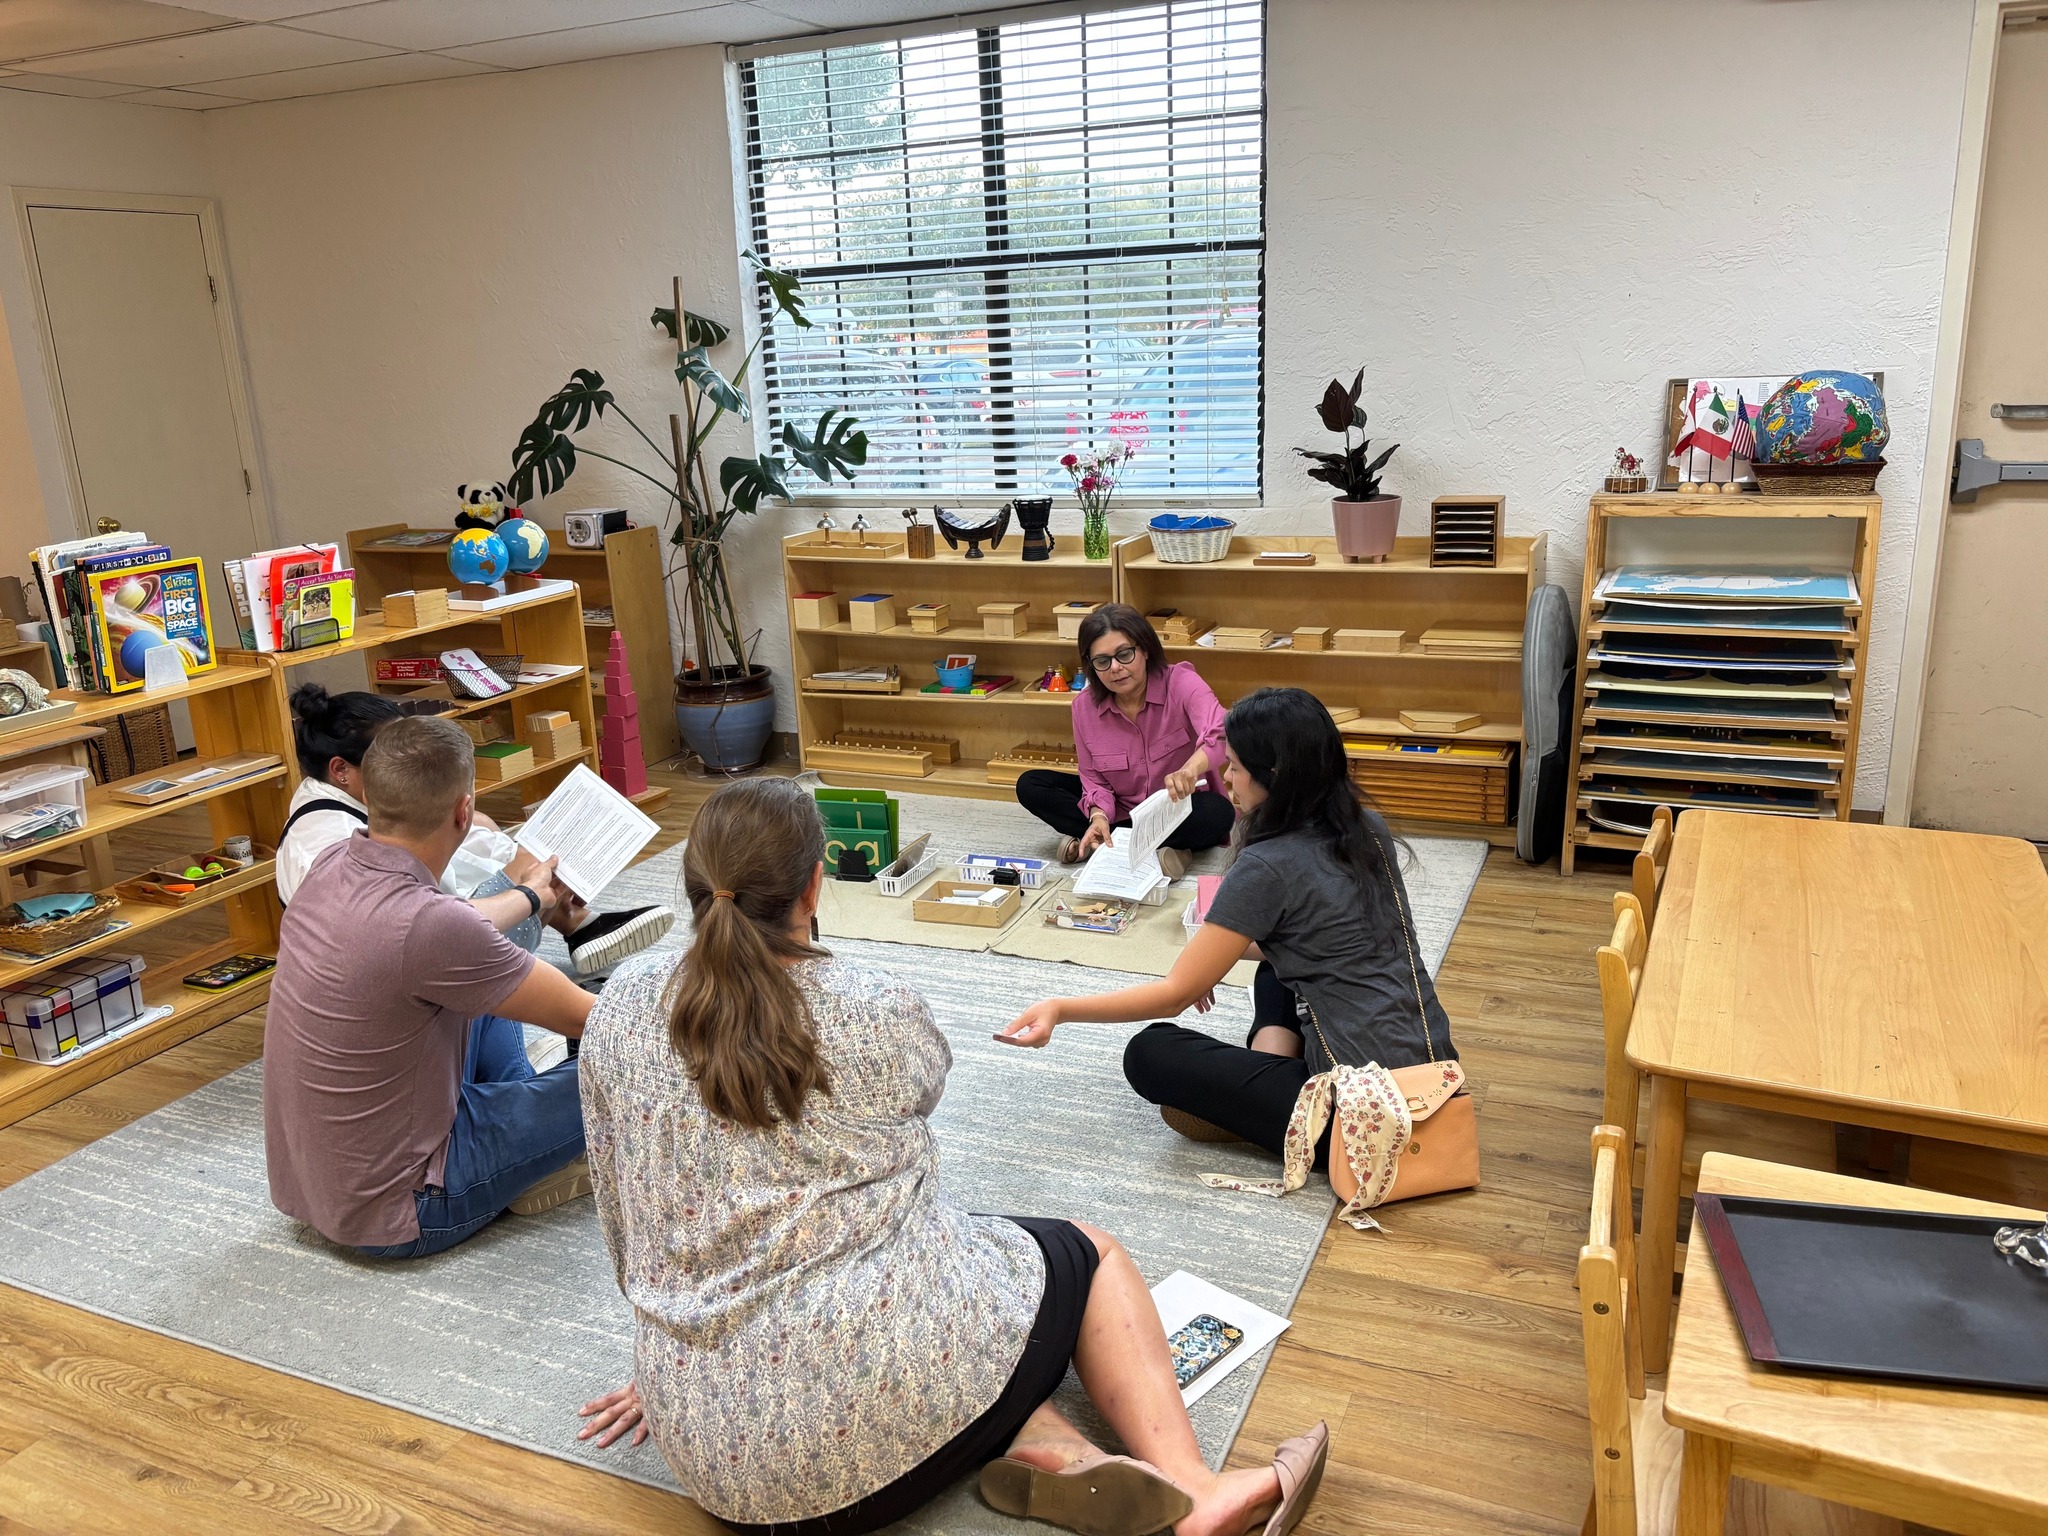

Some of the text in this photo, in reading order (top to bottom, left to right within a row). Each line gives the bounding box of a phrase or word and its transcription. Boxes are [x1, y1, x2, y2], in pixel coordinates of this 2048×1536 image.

[93, 560, 125, 571] FIRST
[173, 577, 193, 588] kids
[163, 587, 195, 600] FIRST
[230, 564, 251, 617] World
[165, 597, 197, 615] BIG
[167, 613, 186, 621] BOOK
[167, 618, 198, 630] SPACE
